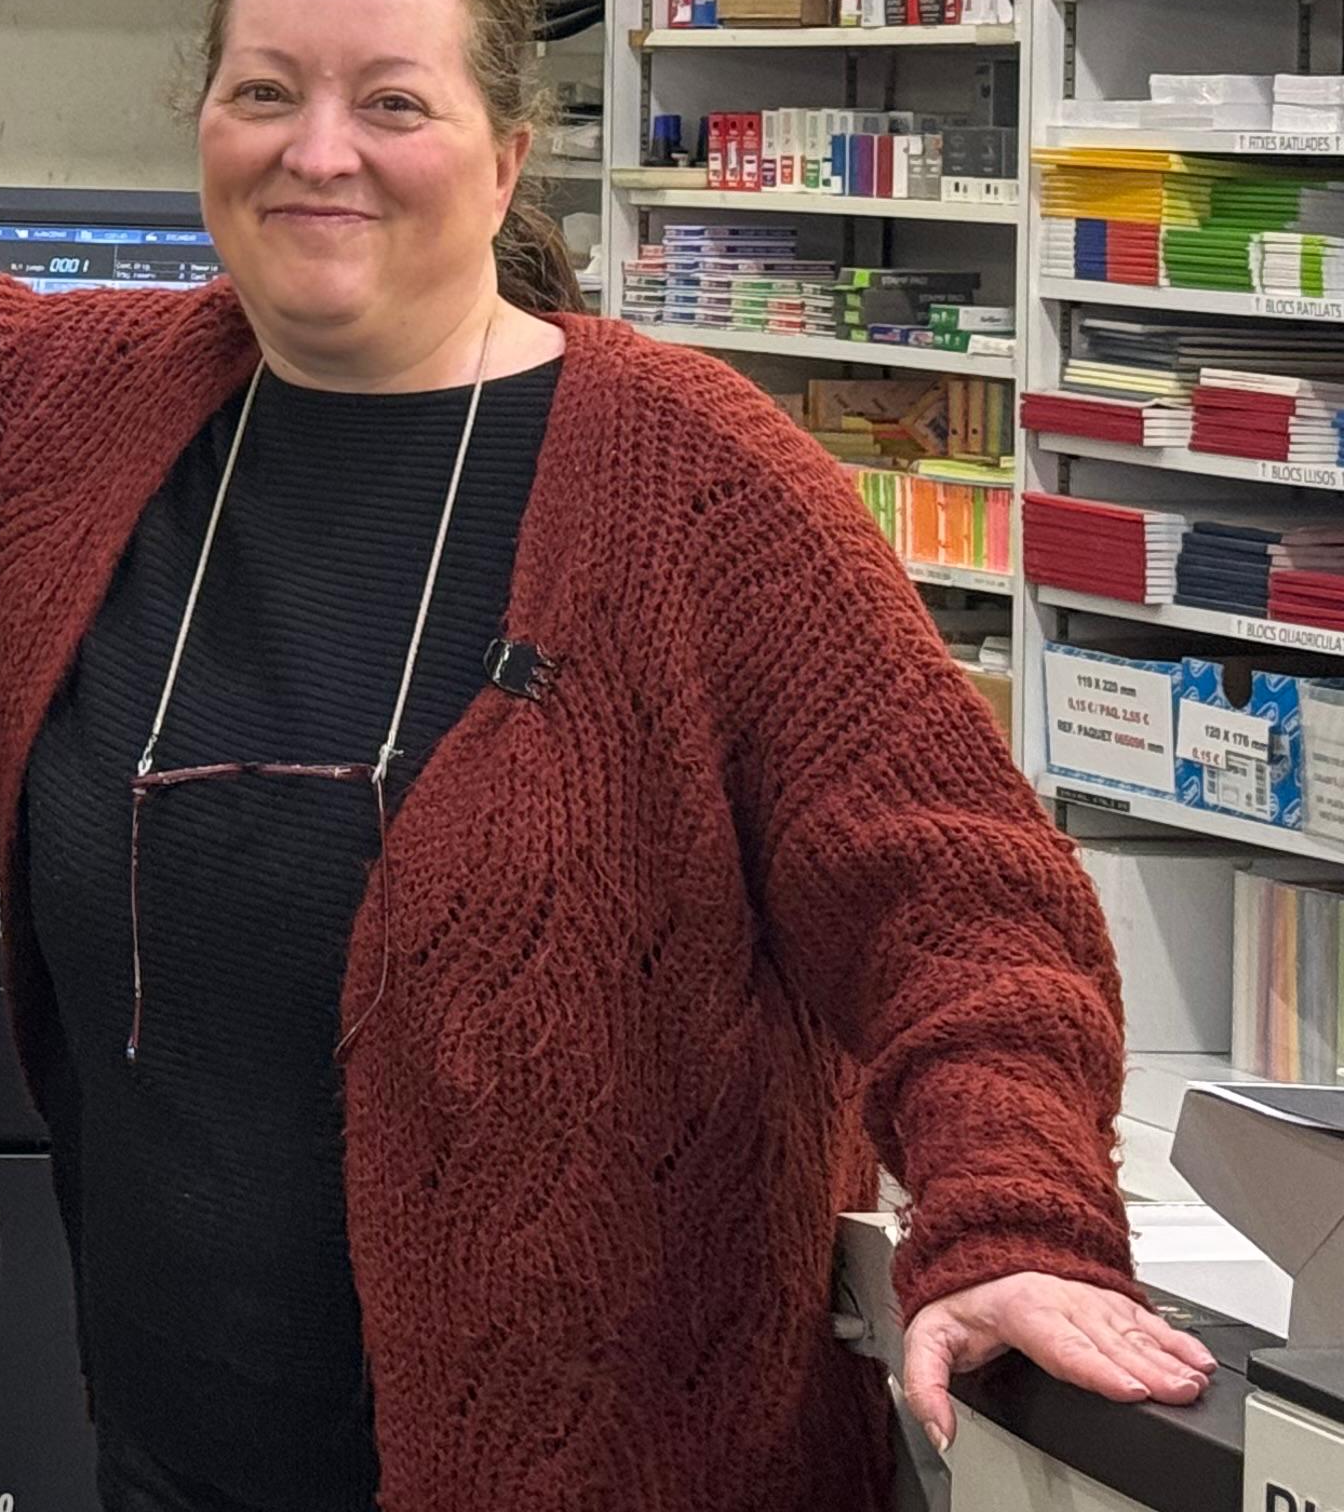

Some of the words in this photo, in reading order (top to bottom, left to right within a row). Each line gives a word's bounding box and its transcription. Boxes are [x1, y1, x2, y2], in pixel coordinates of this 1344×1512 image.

[49, 257, 90, 274] 0001
[1272, 465, 1302, 481] BLOCS
[1247, 623, 1276, 641] BLOCS
[1094, 677, 1101, 688] X
[1142, 712, 1150, 726] €
[1222, 729, 1230, 741] X
[1212, 751, 1221, 765] €
